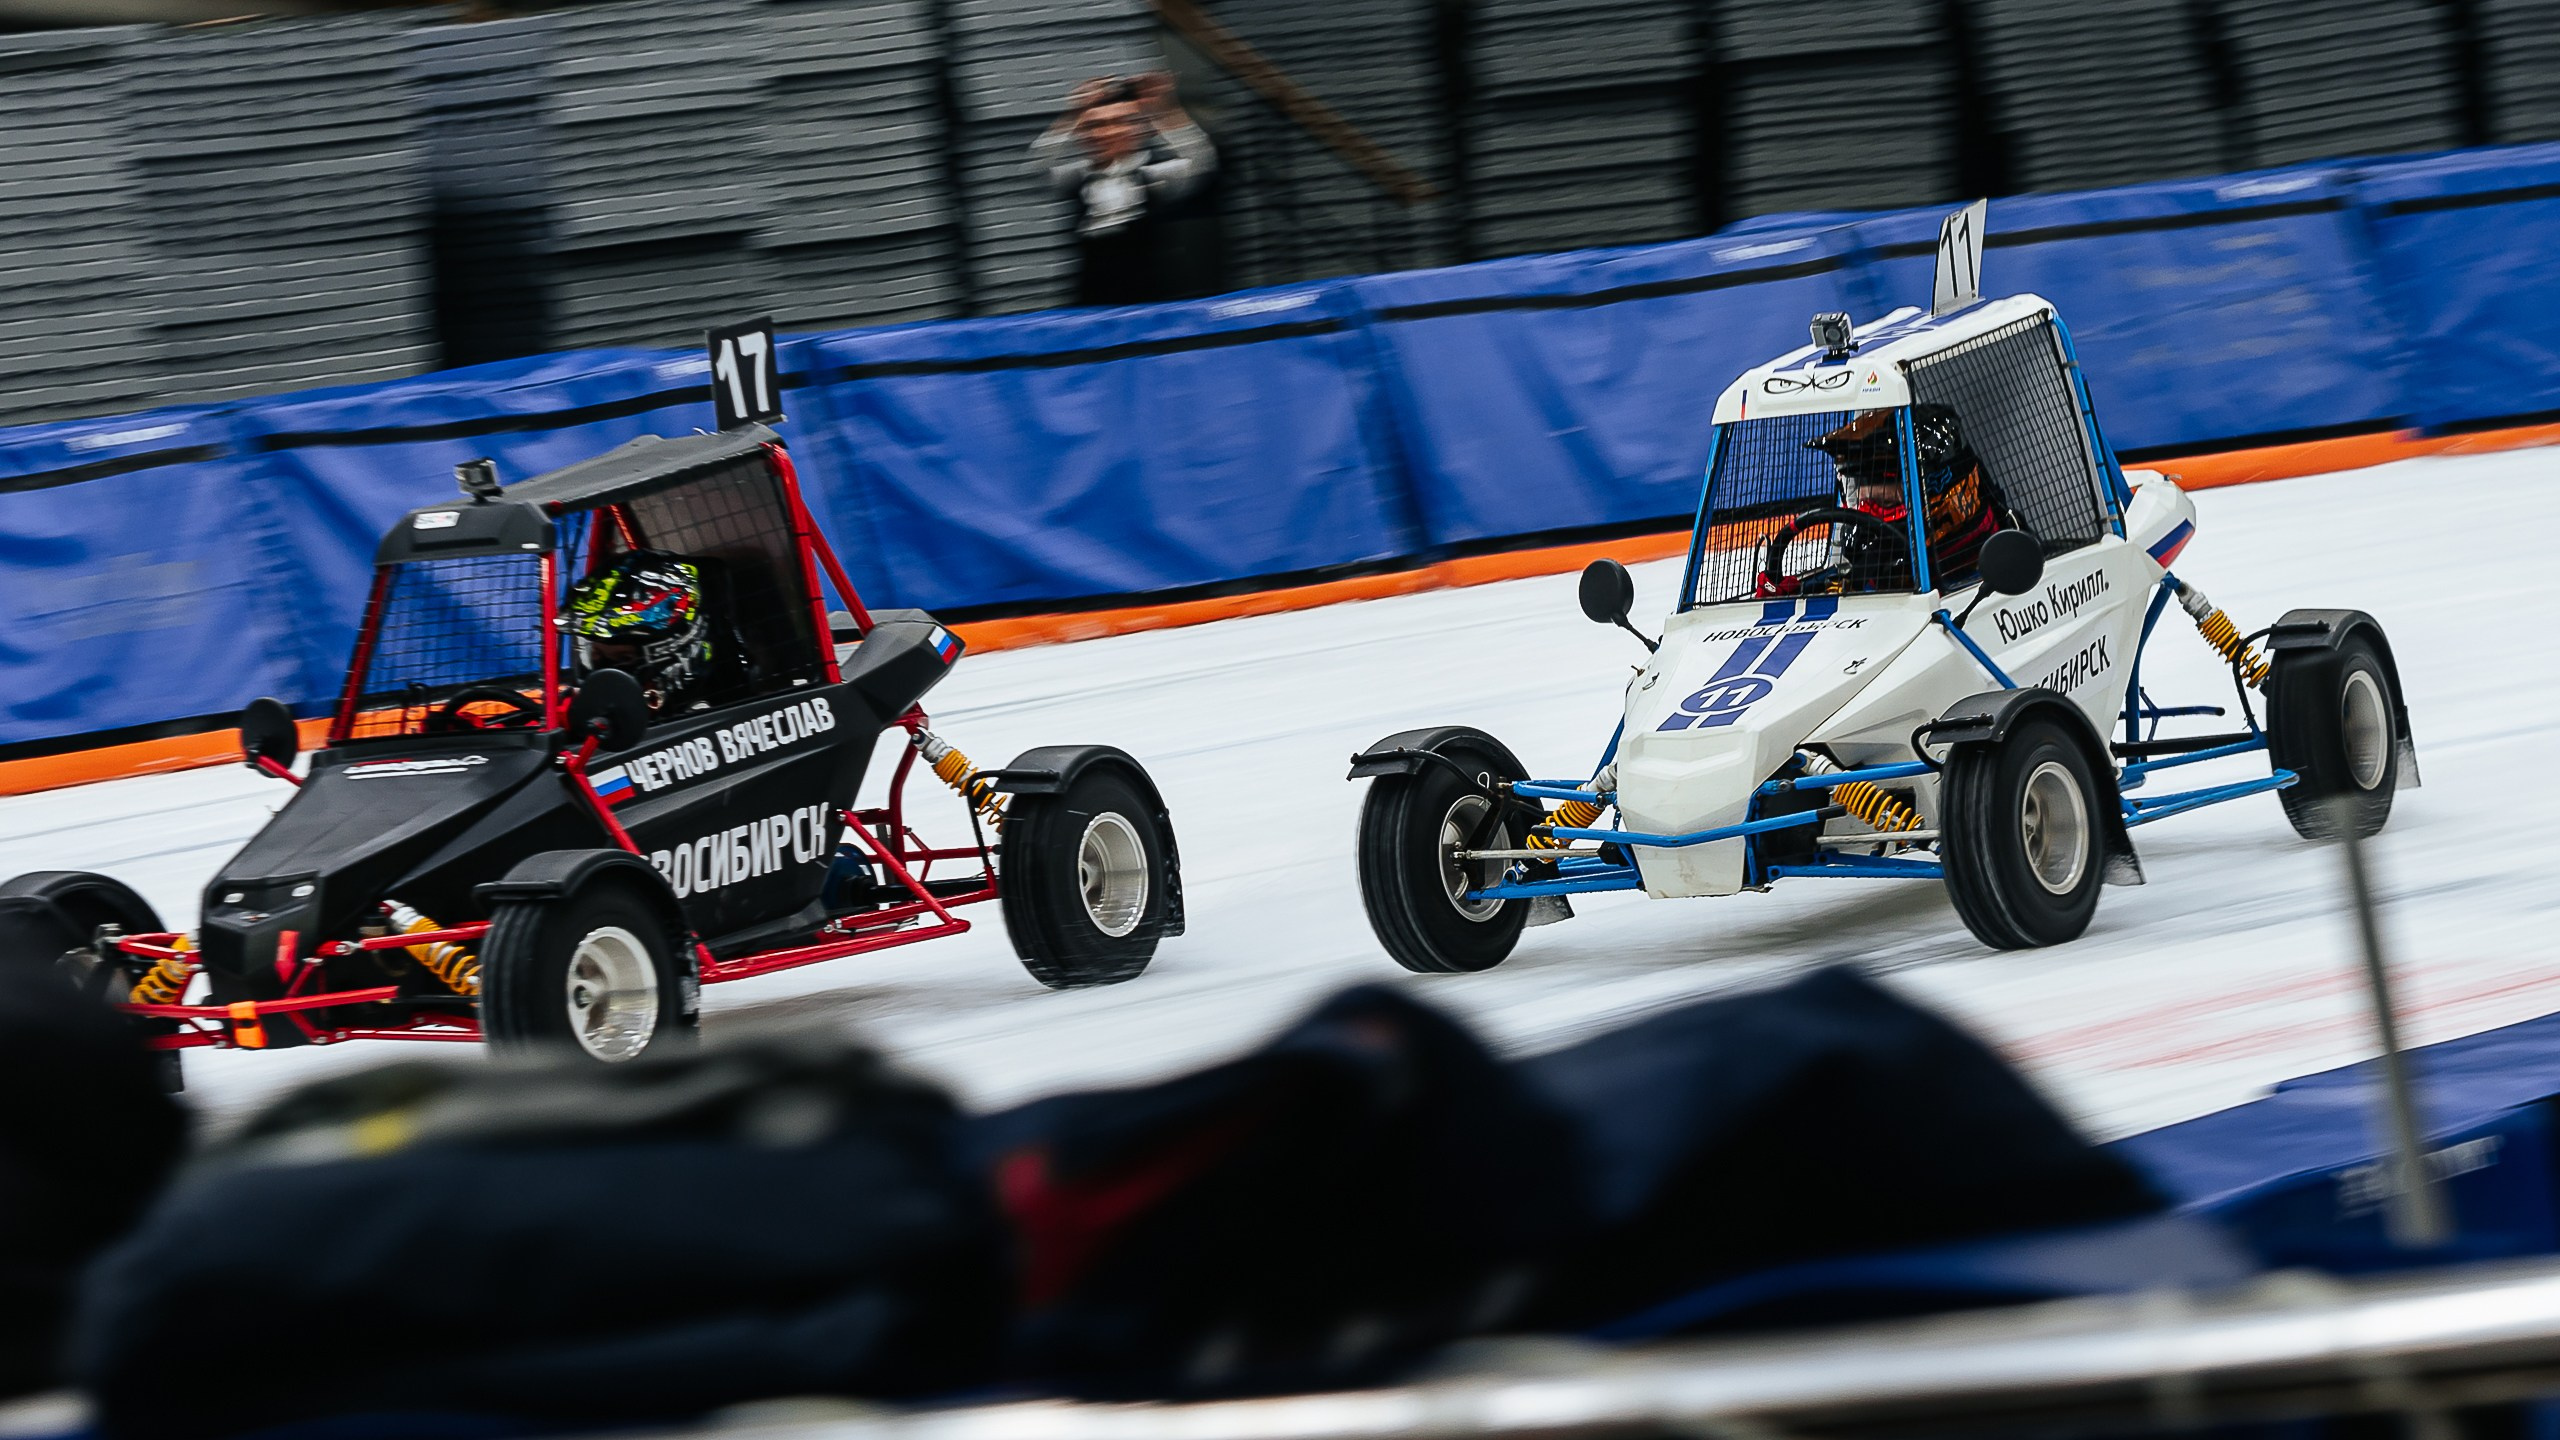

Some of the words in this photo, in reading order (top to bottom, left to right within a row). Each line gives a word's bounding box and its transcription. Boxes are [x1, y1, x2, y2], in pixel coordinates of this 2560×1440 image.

[1941, 212, 1976, 299] 11
[716, 331, 770, 419] 17
[1993, 600, 2050, 645] Юшко
[1699, 682, 1759, 709] 11
[2032, 635, 2111, 697] ИБИРСК
[625, 737, 719, 792] ЧЕРНОВ
[715, 697, 836, 764] ВЯЧЕСЛАВ
